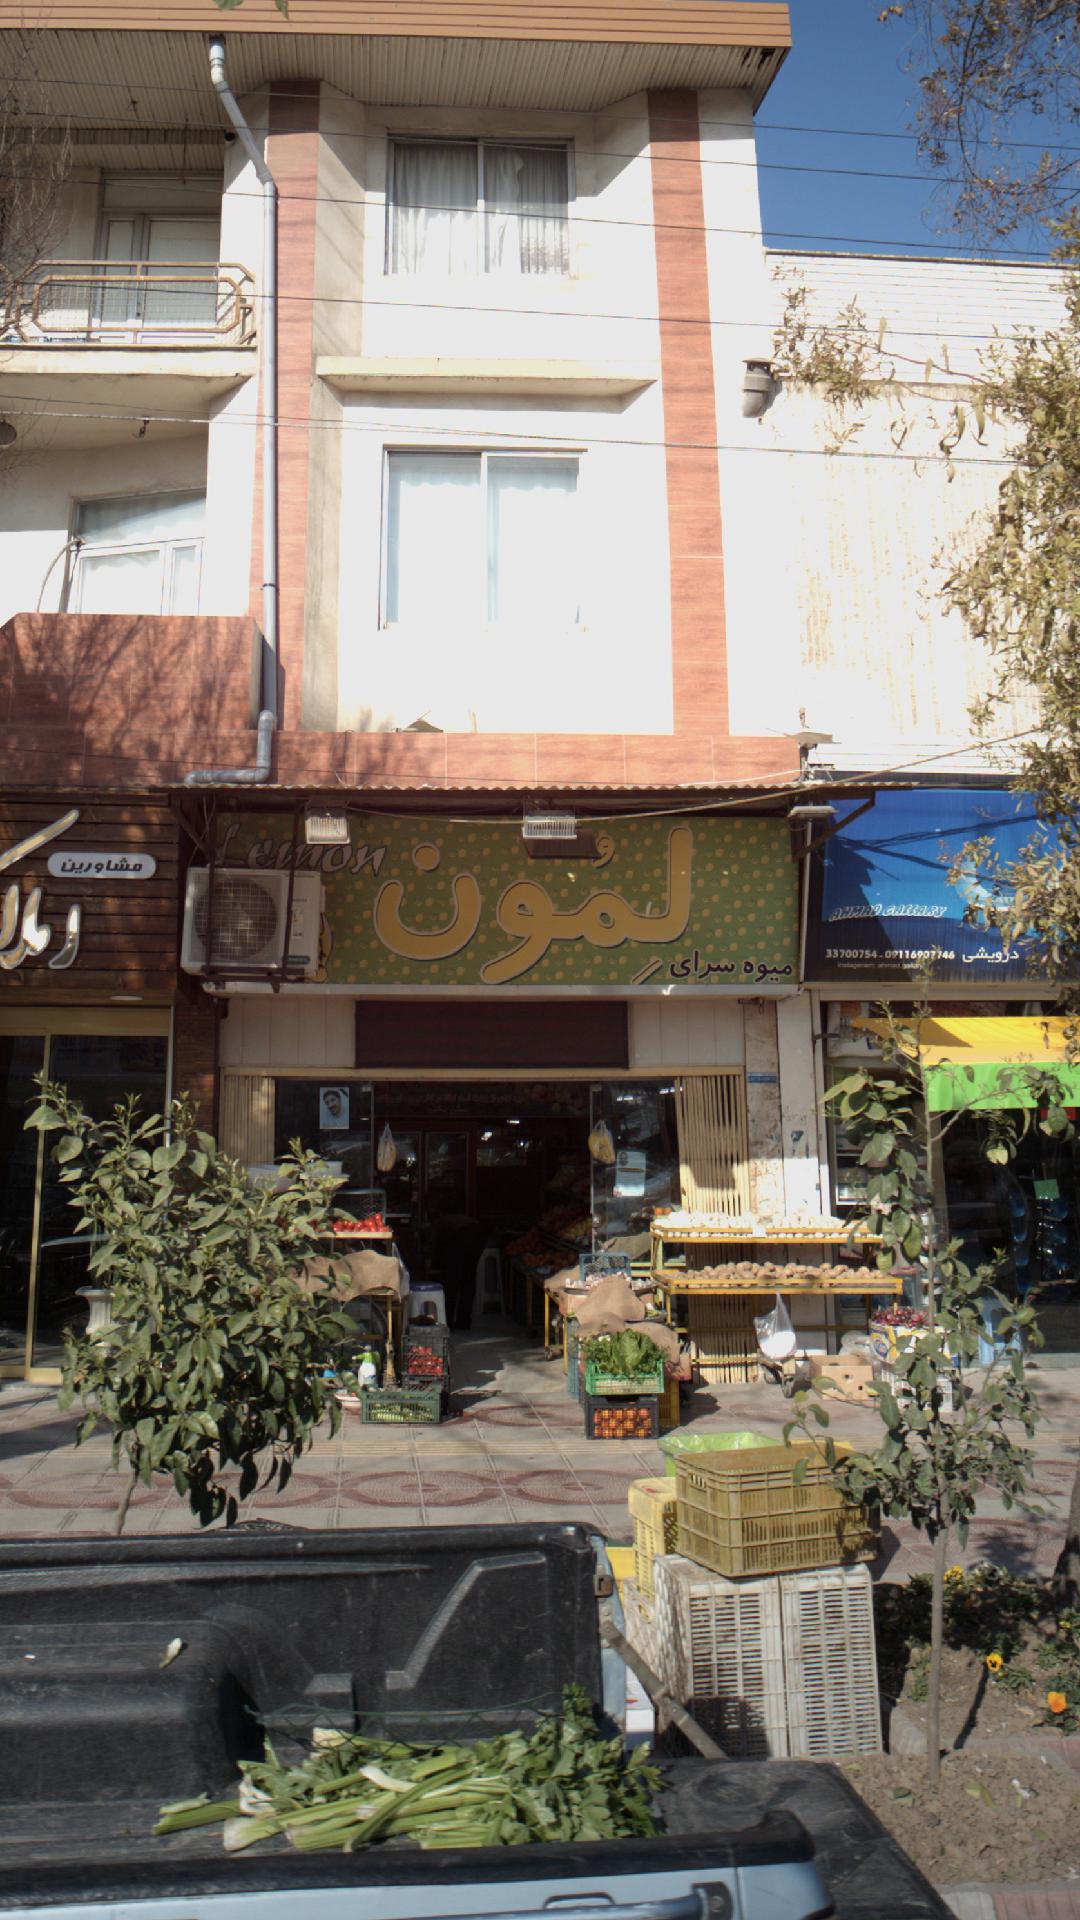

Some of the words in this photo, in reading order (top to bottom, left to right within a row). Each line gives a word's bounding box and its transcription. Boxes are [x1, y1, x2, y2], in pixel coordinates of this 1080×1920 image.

[214, 823, 386, 876] Lemon
[60, 857, 143, 874] مشاورین
[669, 949, 736, 979] سرای
[825, 948, 877, 959] 33700754
[884, 949, 956, 960] 09116907746
[742, 959, 794, 984] میوه
